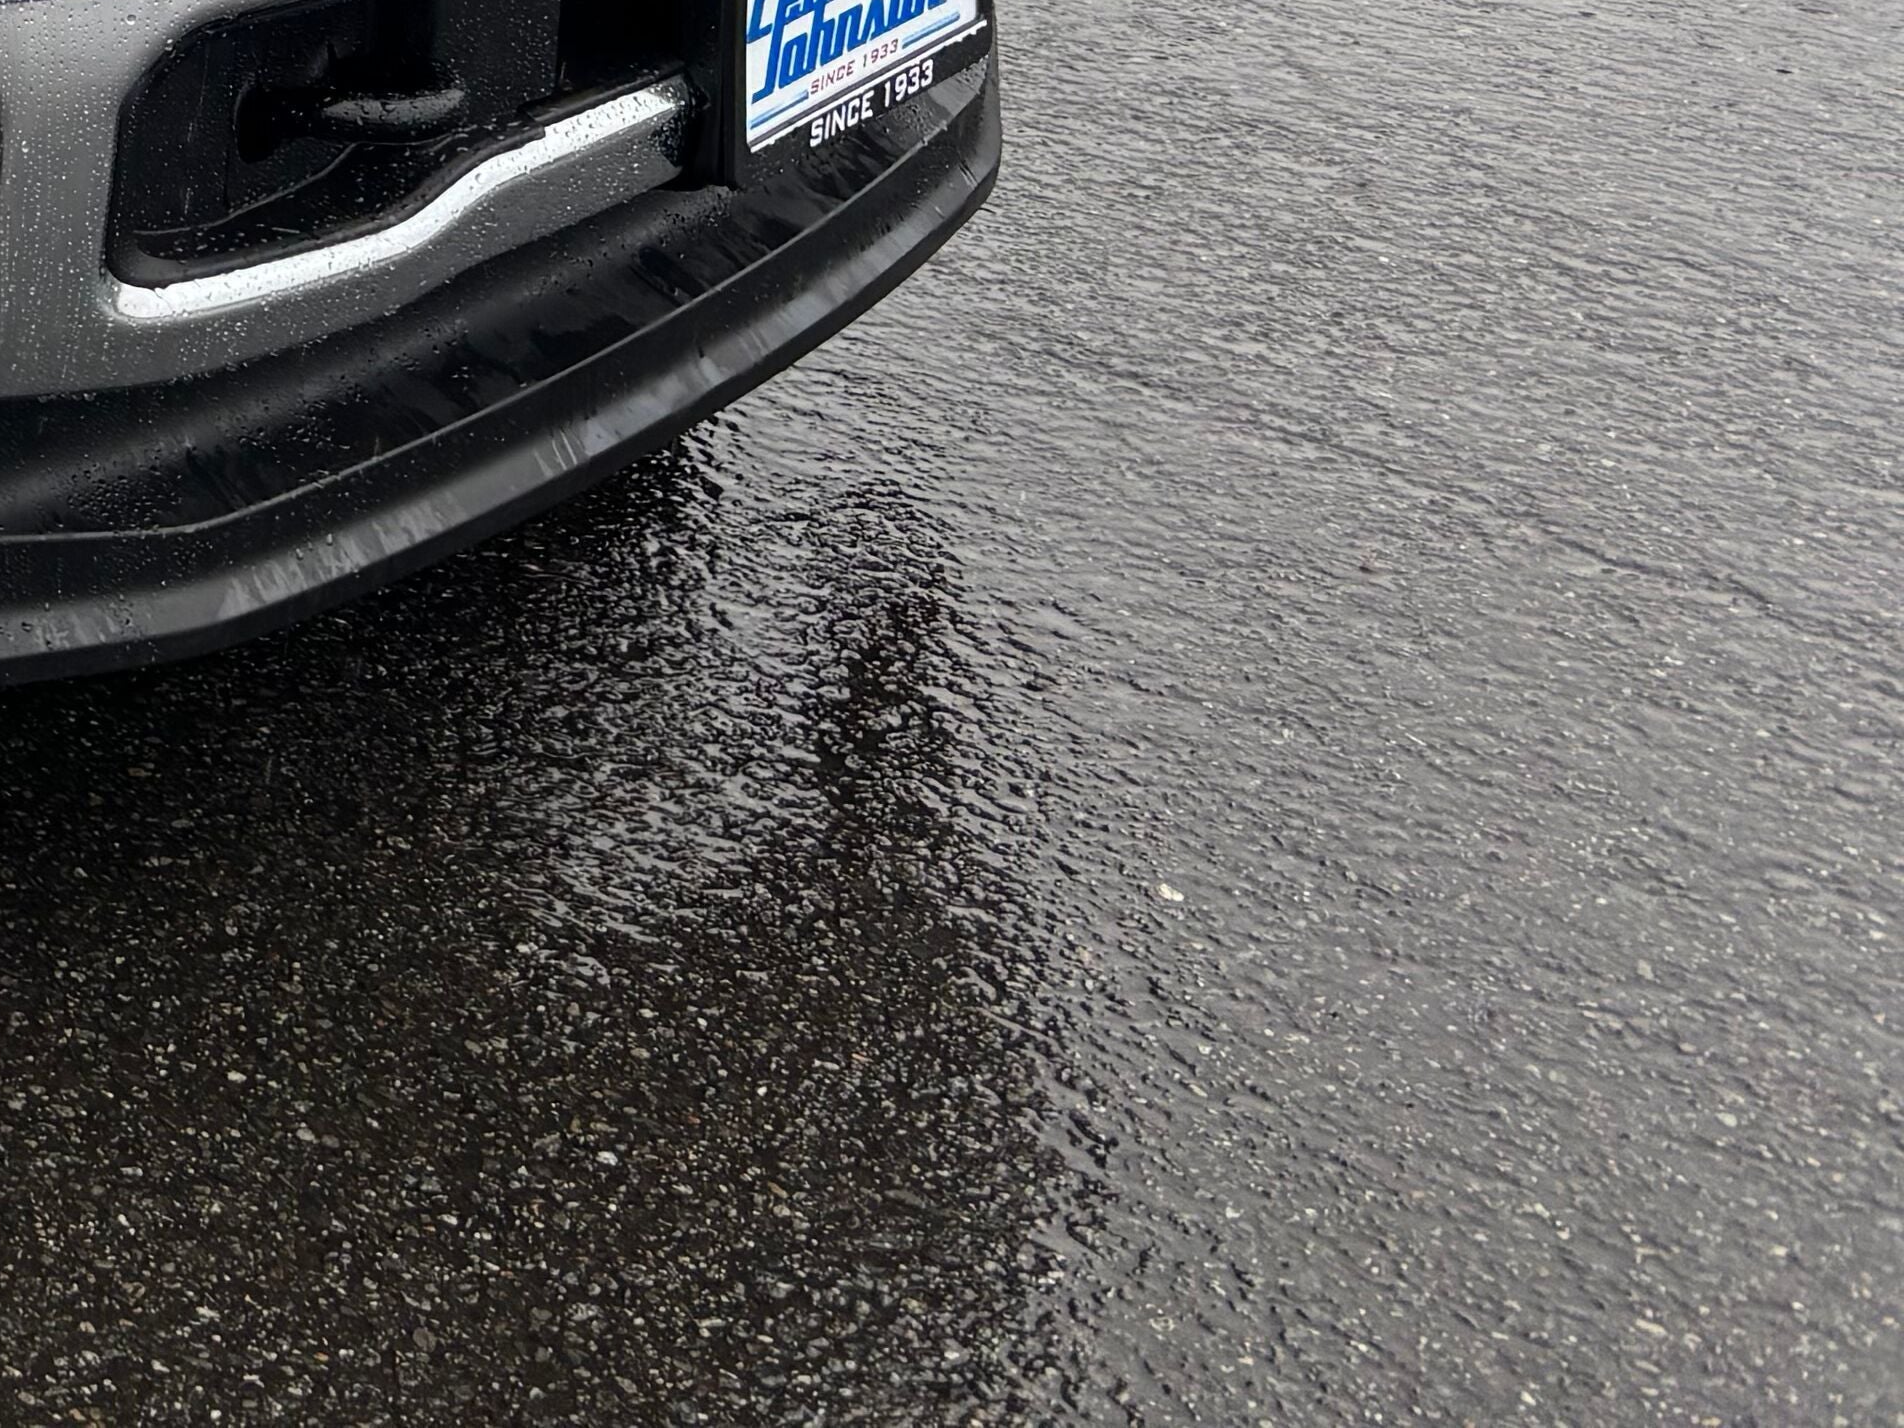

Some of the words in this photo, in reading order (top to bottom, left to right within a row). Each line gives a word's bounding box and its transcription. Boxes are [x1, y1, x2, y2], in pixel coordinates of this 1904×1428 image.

[809, 58, 855, 95] SINCE
[862, 37, 900, 68] 1933
[809, 93, 874, 148] SINCE
[883, 57, 934, 111] 1933
